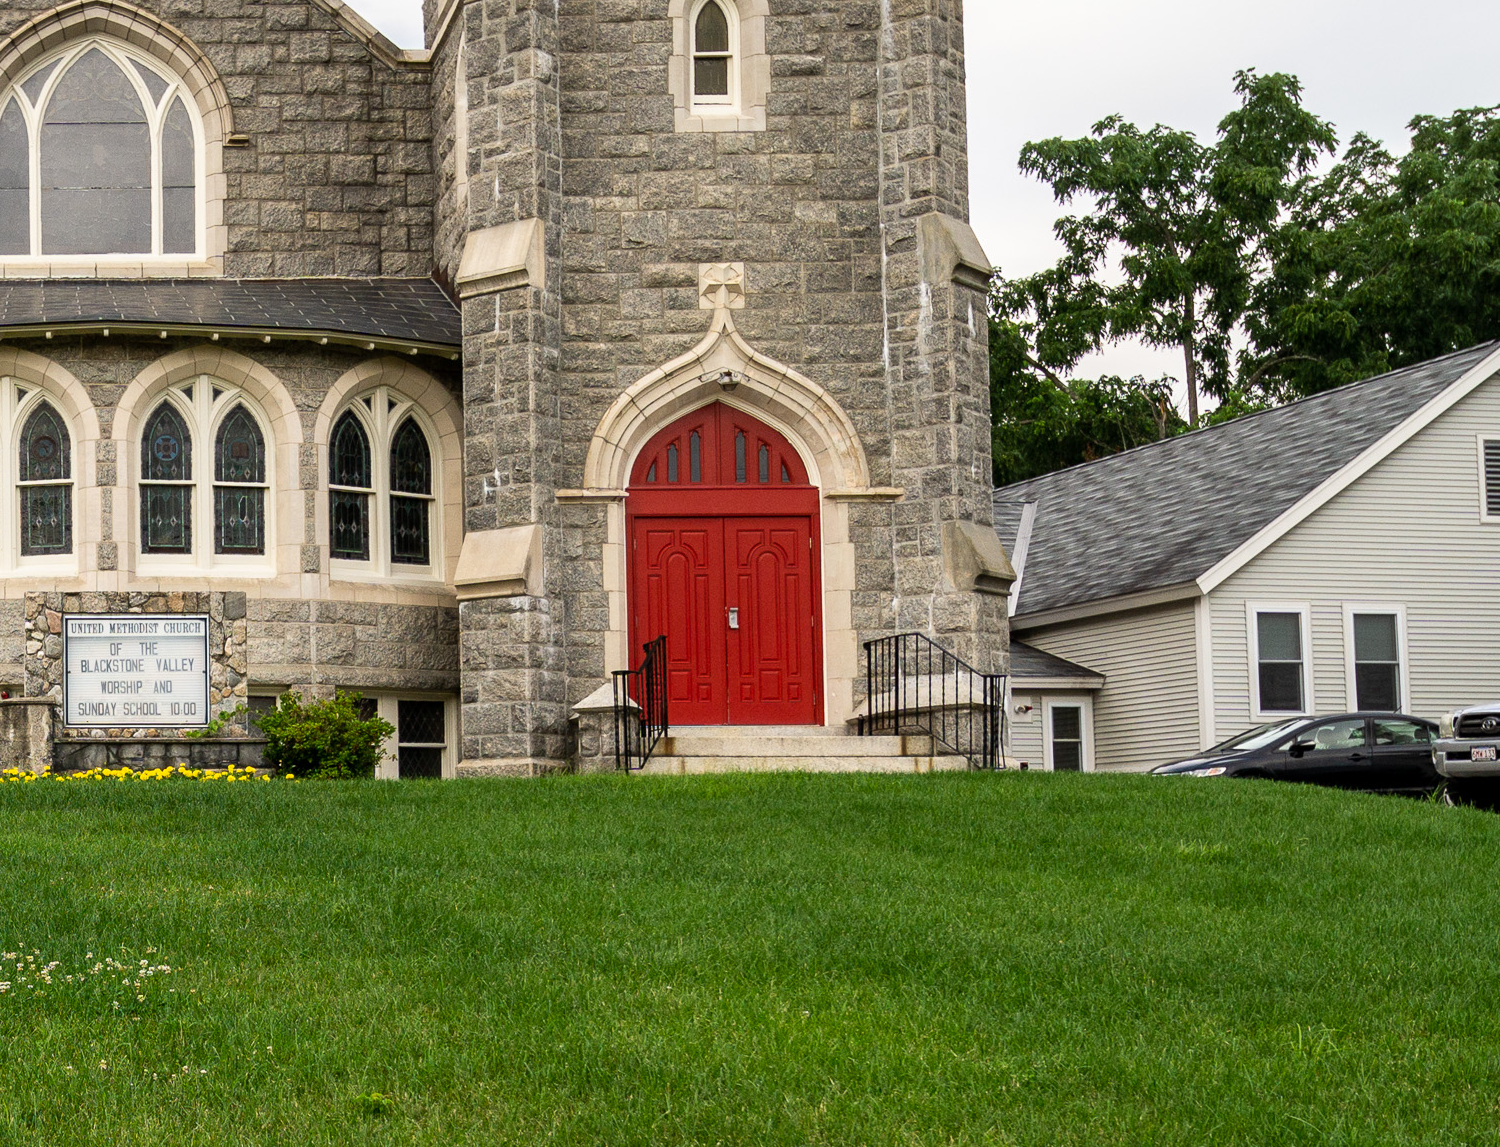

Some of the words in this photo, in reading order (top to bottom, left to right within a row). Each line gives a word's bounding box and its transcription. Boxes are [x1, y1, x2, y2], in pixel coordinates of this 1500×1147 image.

[71, 622, 104, 634] UNITED
[109, 622, 159, 634] METHODIST
[163, 622, 201, 634] CHURCH
[109, 642, 122, 656] OF
[139, 642, 158, 656] THE
[80, 659, 145, 673] BLACKSTONE
[156, 658, 194, 672] VALLEY
[100, 680, 143, 694] WORSHIP
[153, 680, 173, 694] AND
[78, 702, 116, 716] SUNDAY
[123, 702, 161, 716] SCHOOL
[170, 702, 197, 715] 10:00
